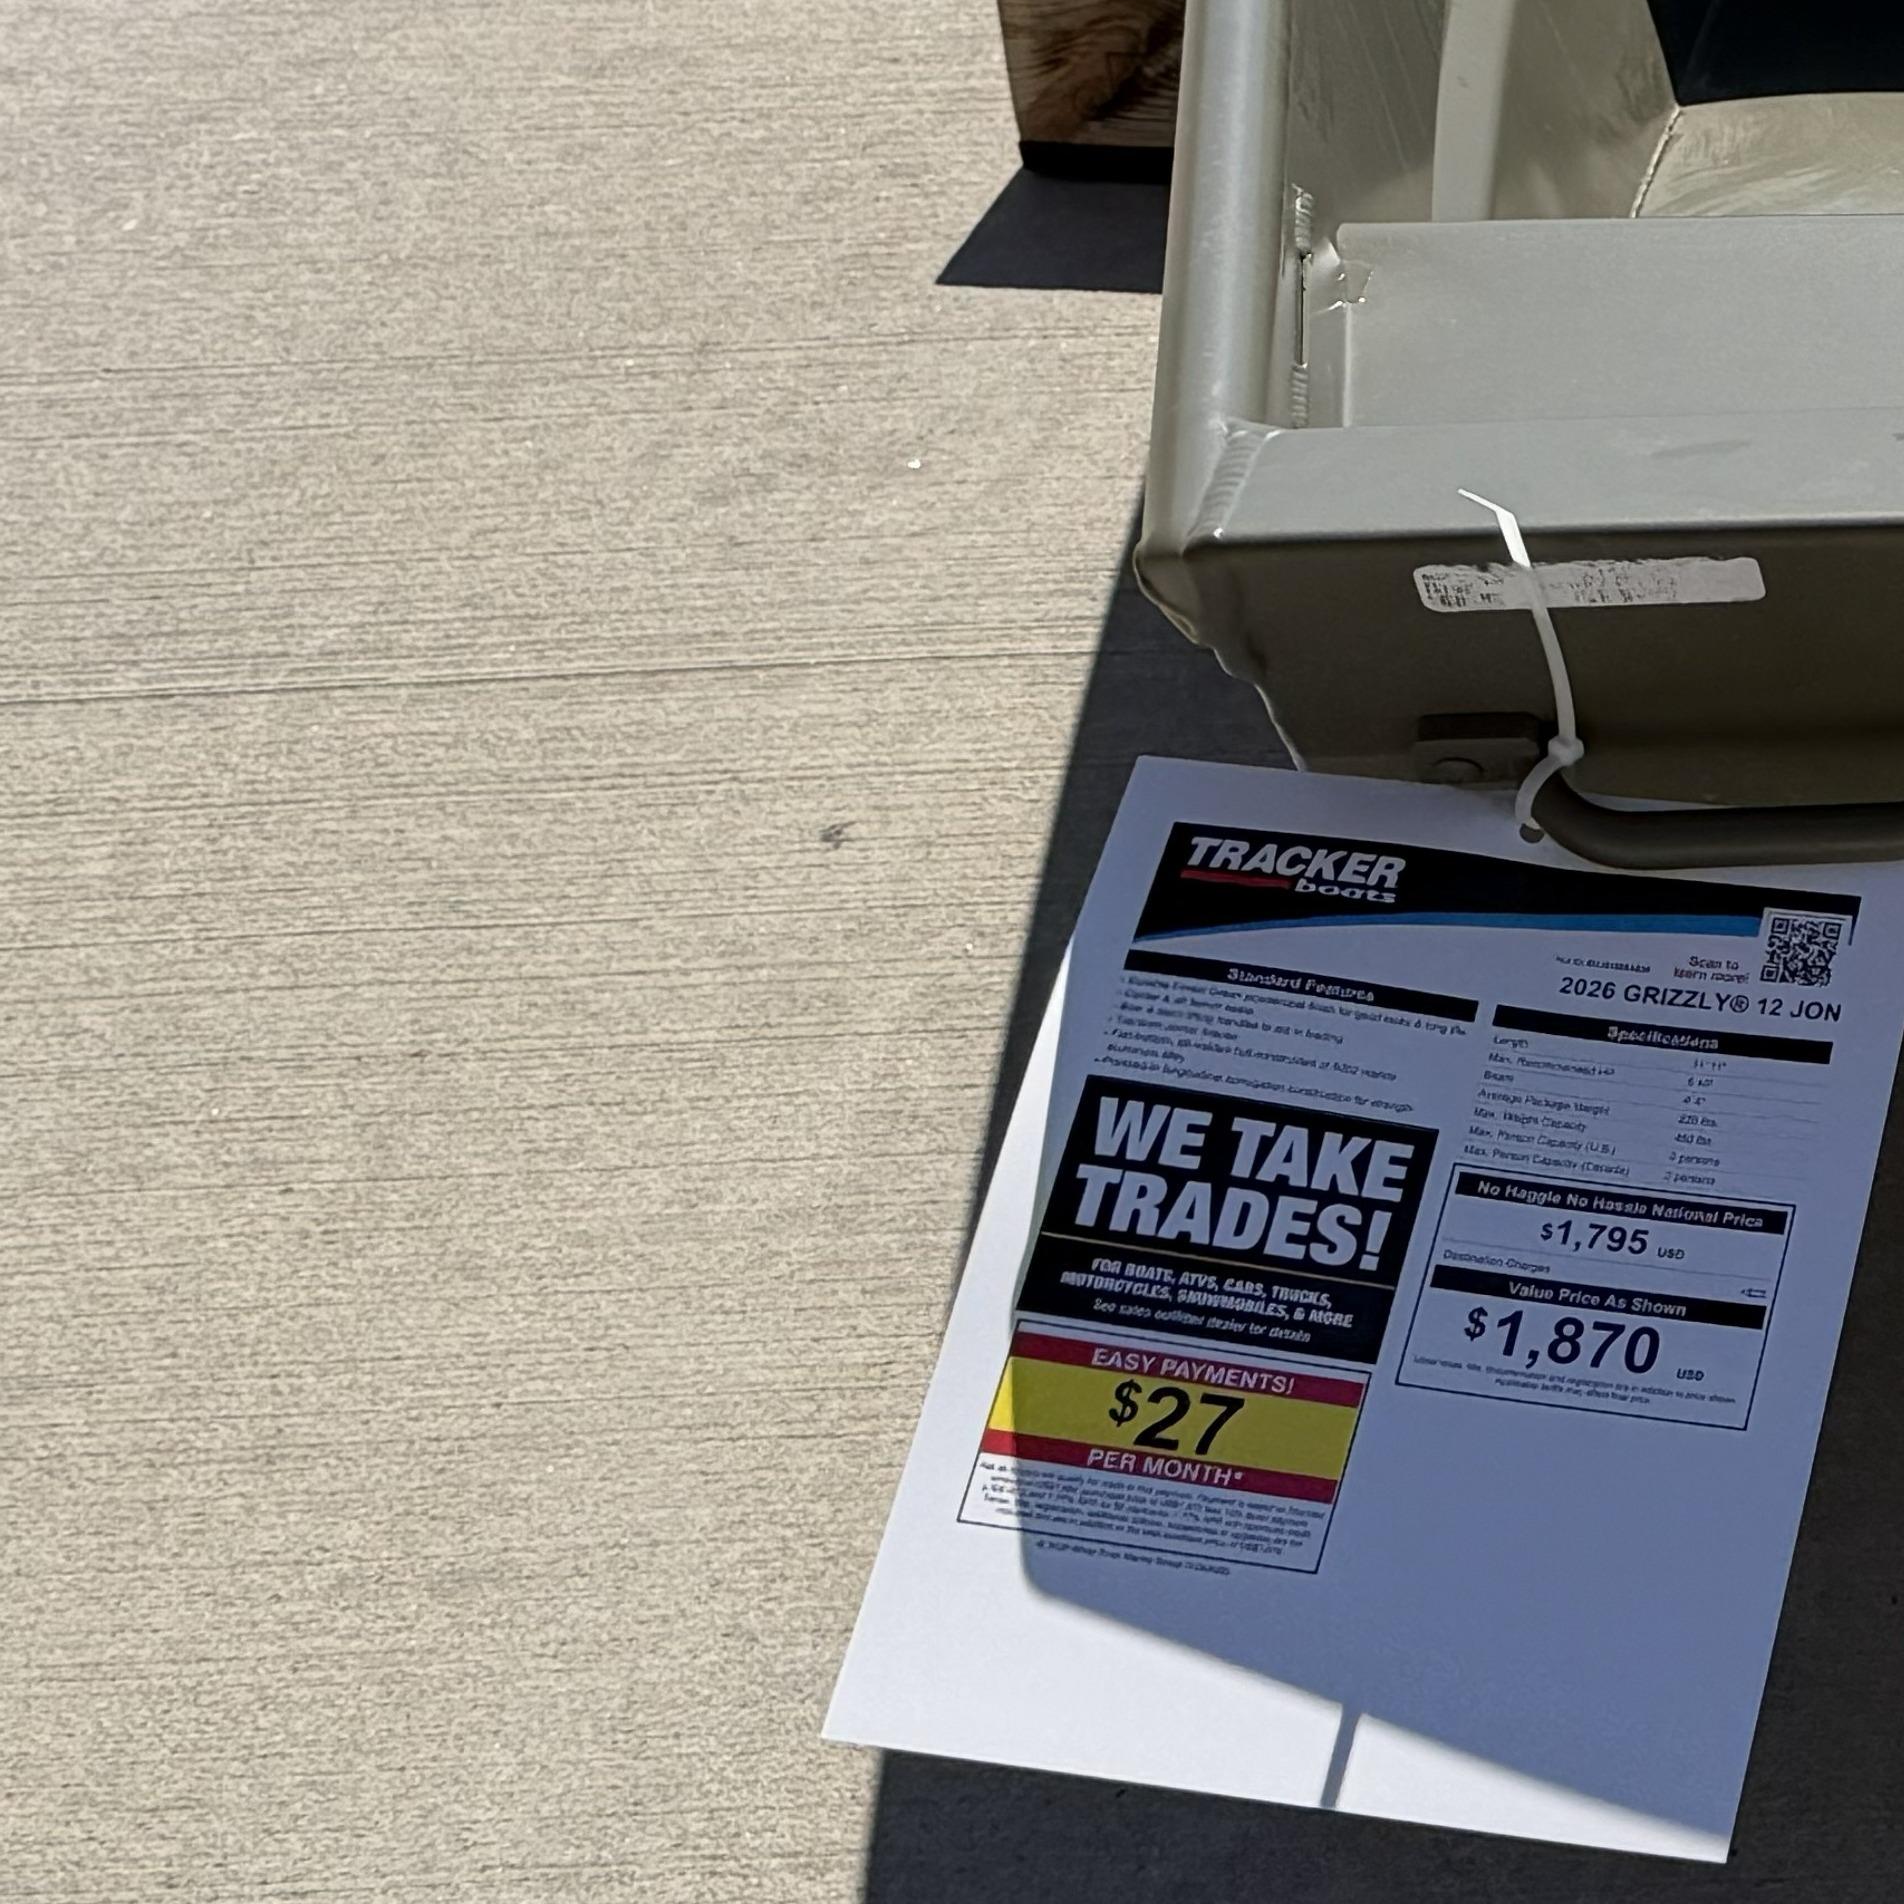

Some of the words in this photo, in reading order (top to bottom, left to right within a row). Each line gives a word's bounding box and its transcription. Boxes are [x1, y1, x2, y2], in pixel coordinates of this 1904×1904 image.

[1187, 835, 1407, 889] TRACKER
[1294, 878, 1398, 905] boats
[1689, 956, 1722, 970] Scan
[1726, 959, 1739, 970] to
[1227, 967, 1302, 991] Standard
[1305, 978, 1375, 1002] Features
[1559, 977, 1616, 999] 2026
[1757, 997, 1783, 1016] 12
[1790, 1000, 1842, 1022] JON
[1608, 1025, 1719, 1050] Specifications
[1093, 1095, 1213, 1169] WE
[1230, 1117, 1416, 1203] TAKE
[1074, 1163, 1392, 1271] TRADES!
[1478, 1180, 1501, 1198] No
[1505, 1184, 1562, 1207] Haggle
[1566, 1192, 1589, 1209] No
[1593, 1195, 1648, 1216] Hassle
[1652, 1203, 1719, 1224] National
[1723, 1210, 1765, 1229] Price
[1540, 1219, 1650, 1255] $1,795
[1658, 1246, 1686, 1260] USD
[1091, 1257, 1122, 1275] FOR
[1124, 1263, 1177, 1285] BOATS,
[1223, 1277, 1266, 1298] CARS,
[1271, 1285, 1333, 1308] TRUCKS,
[1443, 1249, 1505, 1268] Destination
[1507, 1257, 1551, 1275] Charges
[1060, 1271, 1173, 1303] MOTORCYCLES,
[1177, 1288, 1290, 1321] SNOWMOBILES,
[1293, 1307, 1306, 1321] &
[1308, 1311, 1355, 1329] MORE
[1092, 1297, 1115, 1312] See
[1249, 1322, 1268, 1335] for
[1509, 1281, 1554, 1300] Value
[1559, 1287, 1601, 1307] Price
[1604, 1293, 1627, 1309] As
[1631, 1297, 1687, 1317] Shown
[1091, 1347, 1158, 1375] EASY
[1159, 1353, 1297, 1397] PAYMENTS!
[1676, 1367, 1706, 1382] USD
[1108, 1378, 1247, 1458] $27
[1088, 1448, 1136, 1474] PER
